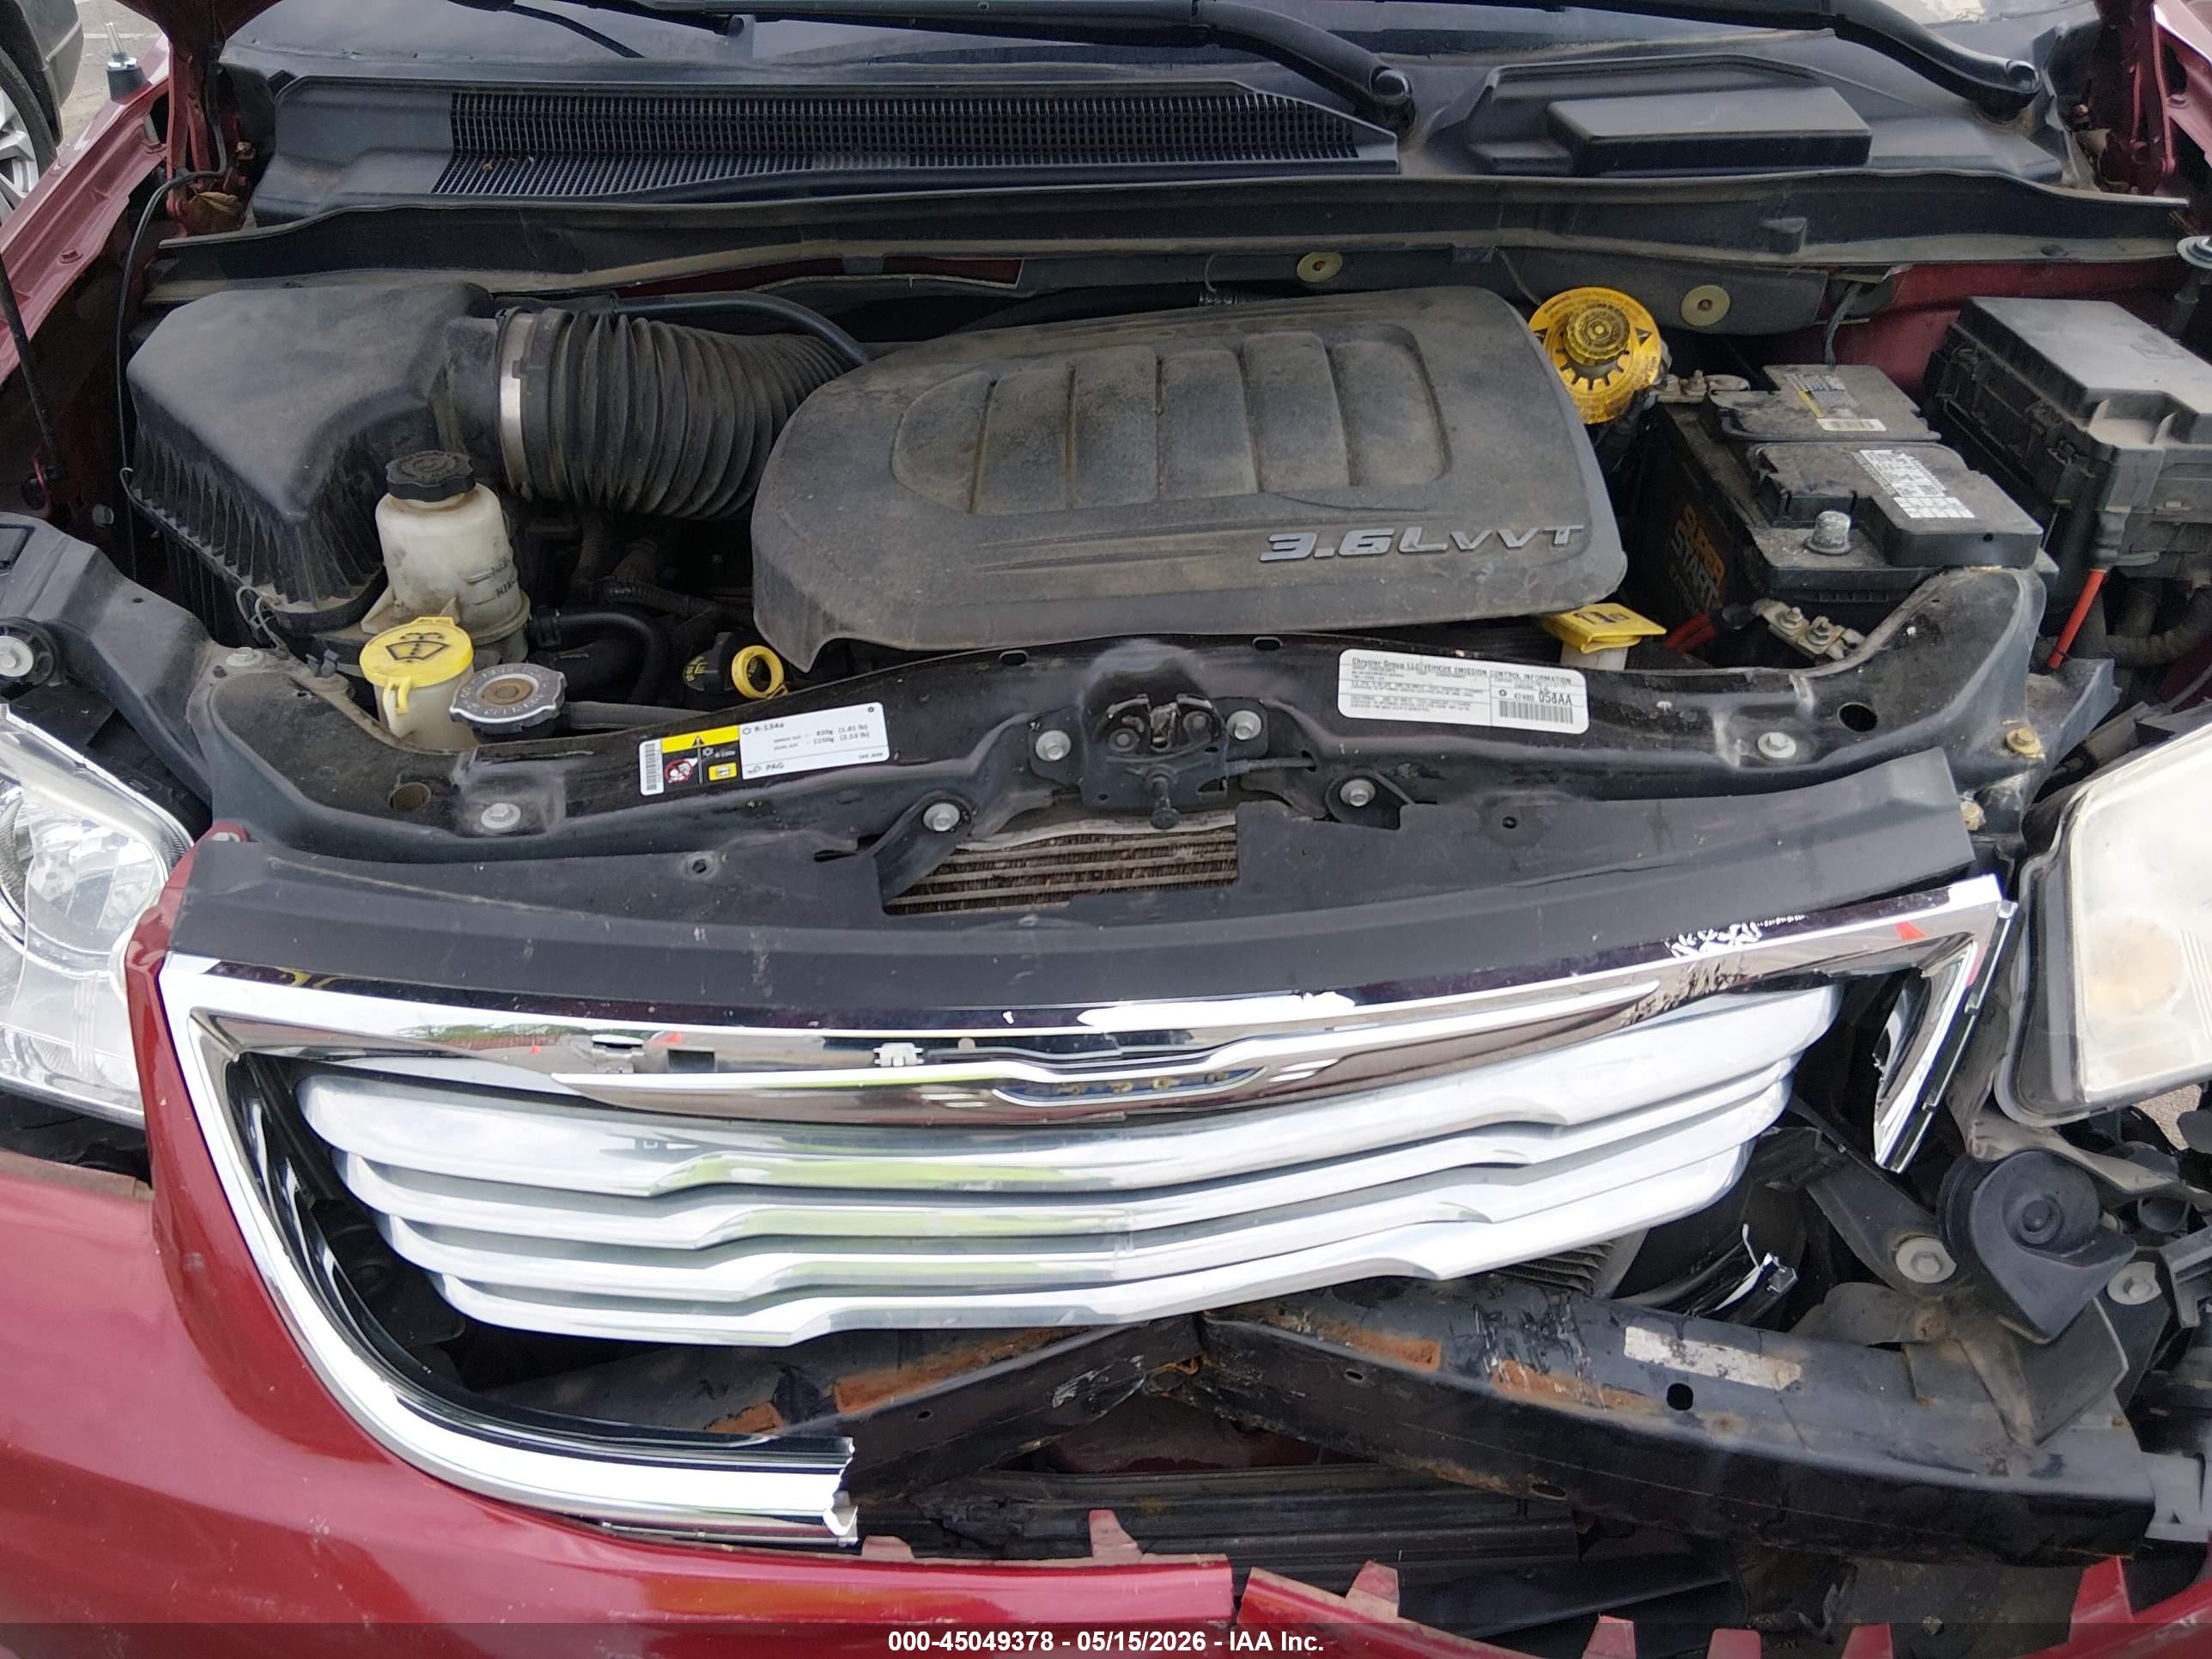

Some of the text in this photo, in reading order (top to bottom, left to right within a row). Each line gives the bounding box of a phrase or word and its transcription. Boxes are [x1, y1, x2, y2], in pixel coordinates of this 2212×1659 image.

[1351, 657, 1382, 669] Chrysler
[1382, 659, 1405, 670] Group
[1454, 666, 1487, 677] EMISSION
[1490, 670, 1521, 680] CONTROL
[1523, 673, 1572, 684] INFORMATION
